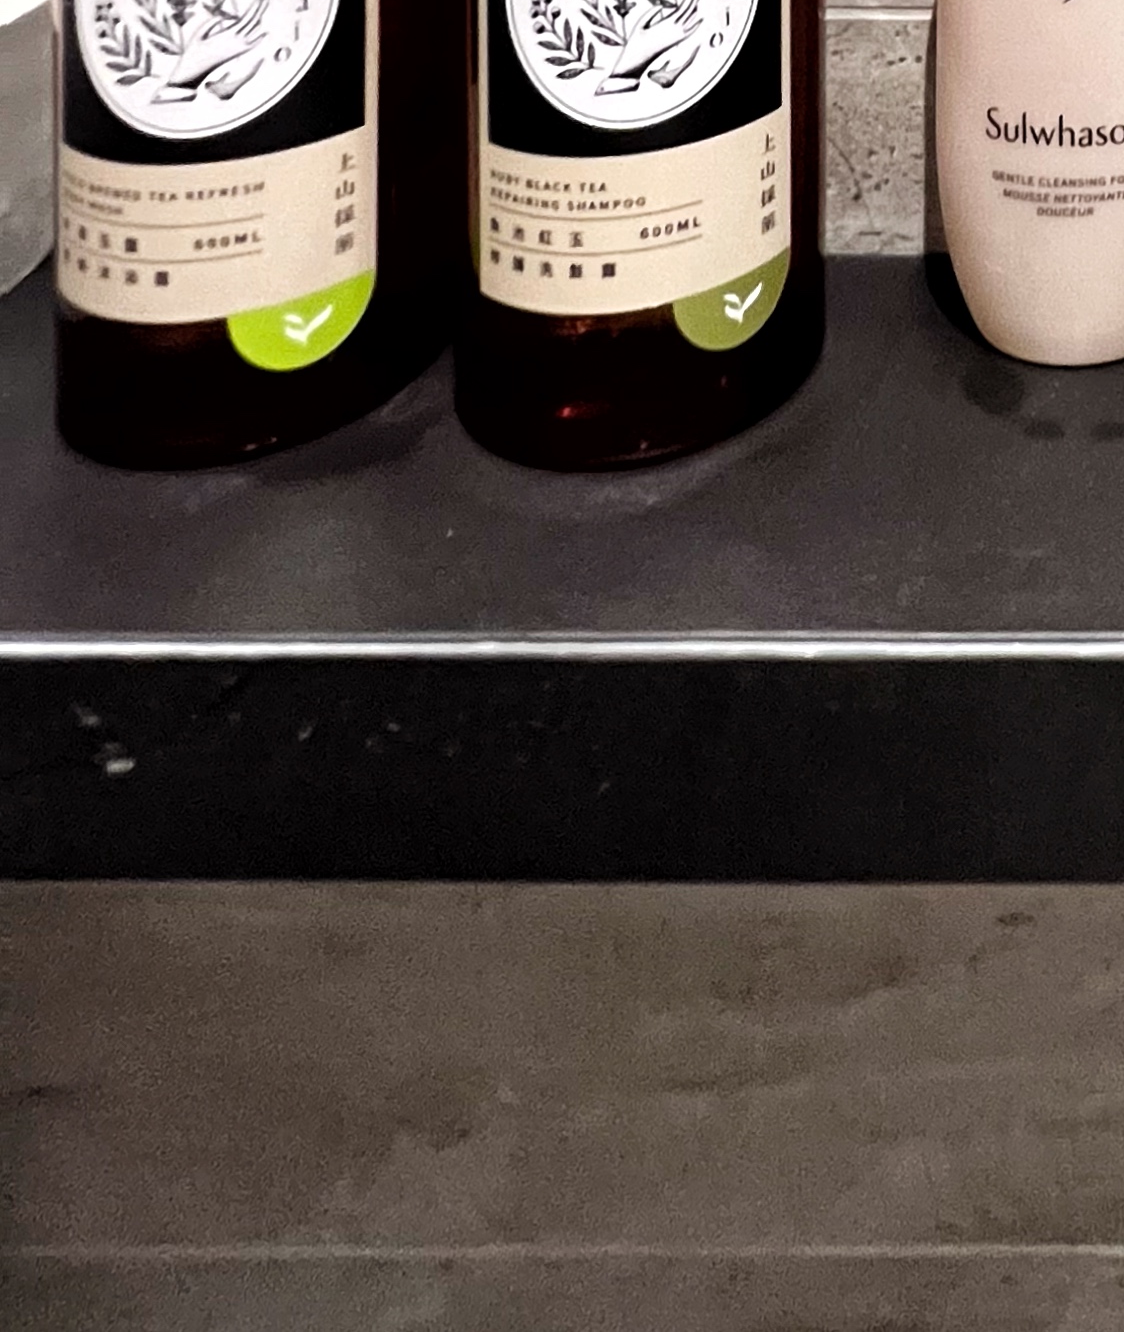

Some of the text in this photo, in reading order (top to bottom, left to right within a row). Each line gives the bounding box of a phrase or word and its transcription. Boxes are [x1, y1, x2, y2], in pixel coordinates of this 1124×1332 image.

[525, 179, 572, 193] BLACK
[580, 182, 608, 193] TEA
[992, 170, 1035, 187] GENTLE
[1038, 176, 1107, 188] CLEANSING
[1003, 188, 1049, 203] MOUSSE
[567, 196, 647, 211] SHAMPOO
[1036, 207, 1095, 217] DOUCEUR
[639, 216, 702, 240] 600ML
